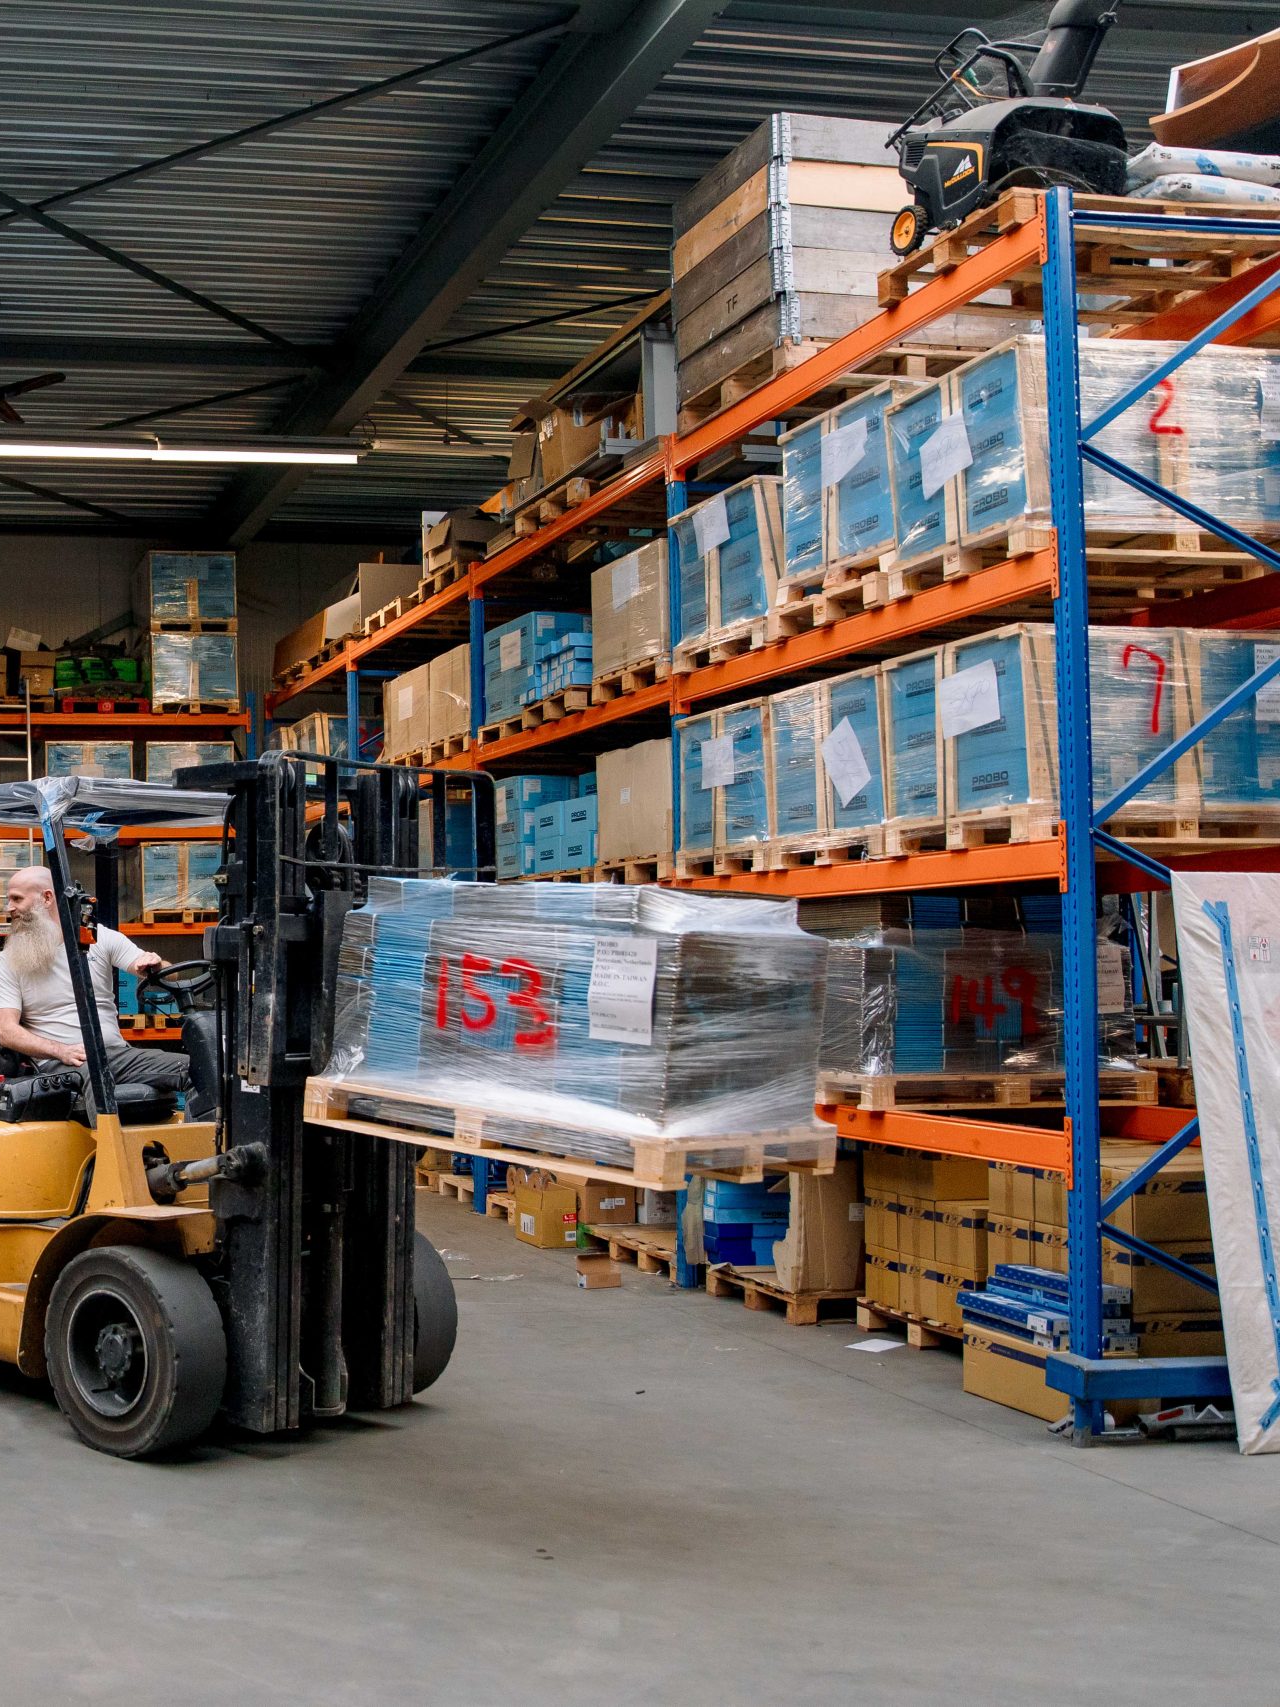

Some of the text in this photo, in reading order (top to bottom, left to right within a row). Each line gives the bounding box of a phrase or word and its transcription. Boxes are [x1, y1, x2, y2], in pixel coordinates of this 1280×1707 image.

[1149, 377, 1184, 435] 2
[849, 514, 879, 532] PROBO
[1123, 643, 1166, 735] 7
[838, 698, 866, 713] PROBO
[972, 770, 1009, 786] PROBO
[571, 810, 587, 818] PROBO
[568, 845, 583, 853] PROBO
[435, 950, 558, 1050] 153
[951, 965, 1039, 1036] 149
